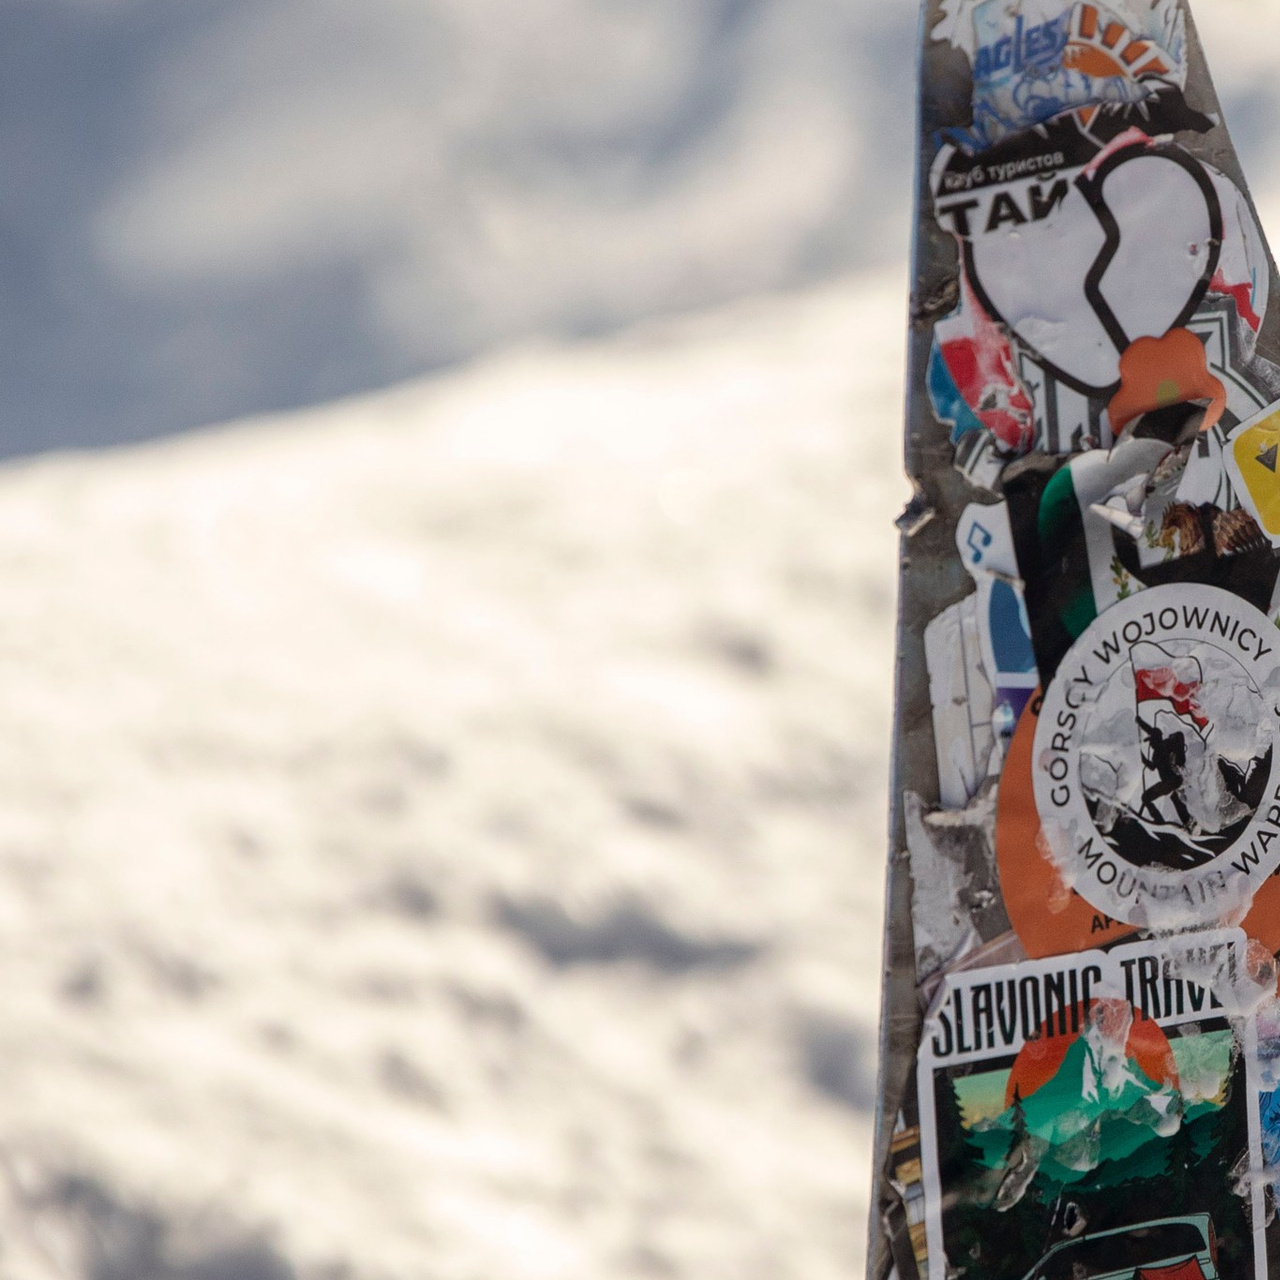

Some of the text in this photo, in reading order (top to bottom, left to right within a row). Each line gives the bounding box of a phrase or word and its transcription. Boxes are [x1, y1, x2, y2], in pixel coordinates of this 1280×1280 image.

[988, 151, 1065, 182] туристов
[939, 170, 1070, 237] ТАЙ
[1093, 605, 1272, 666] WOJOWNICY
